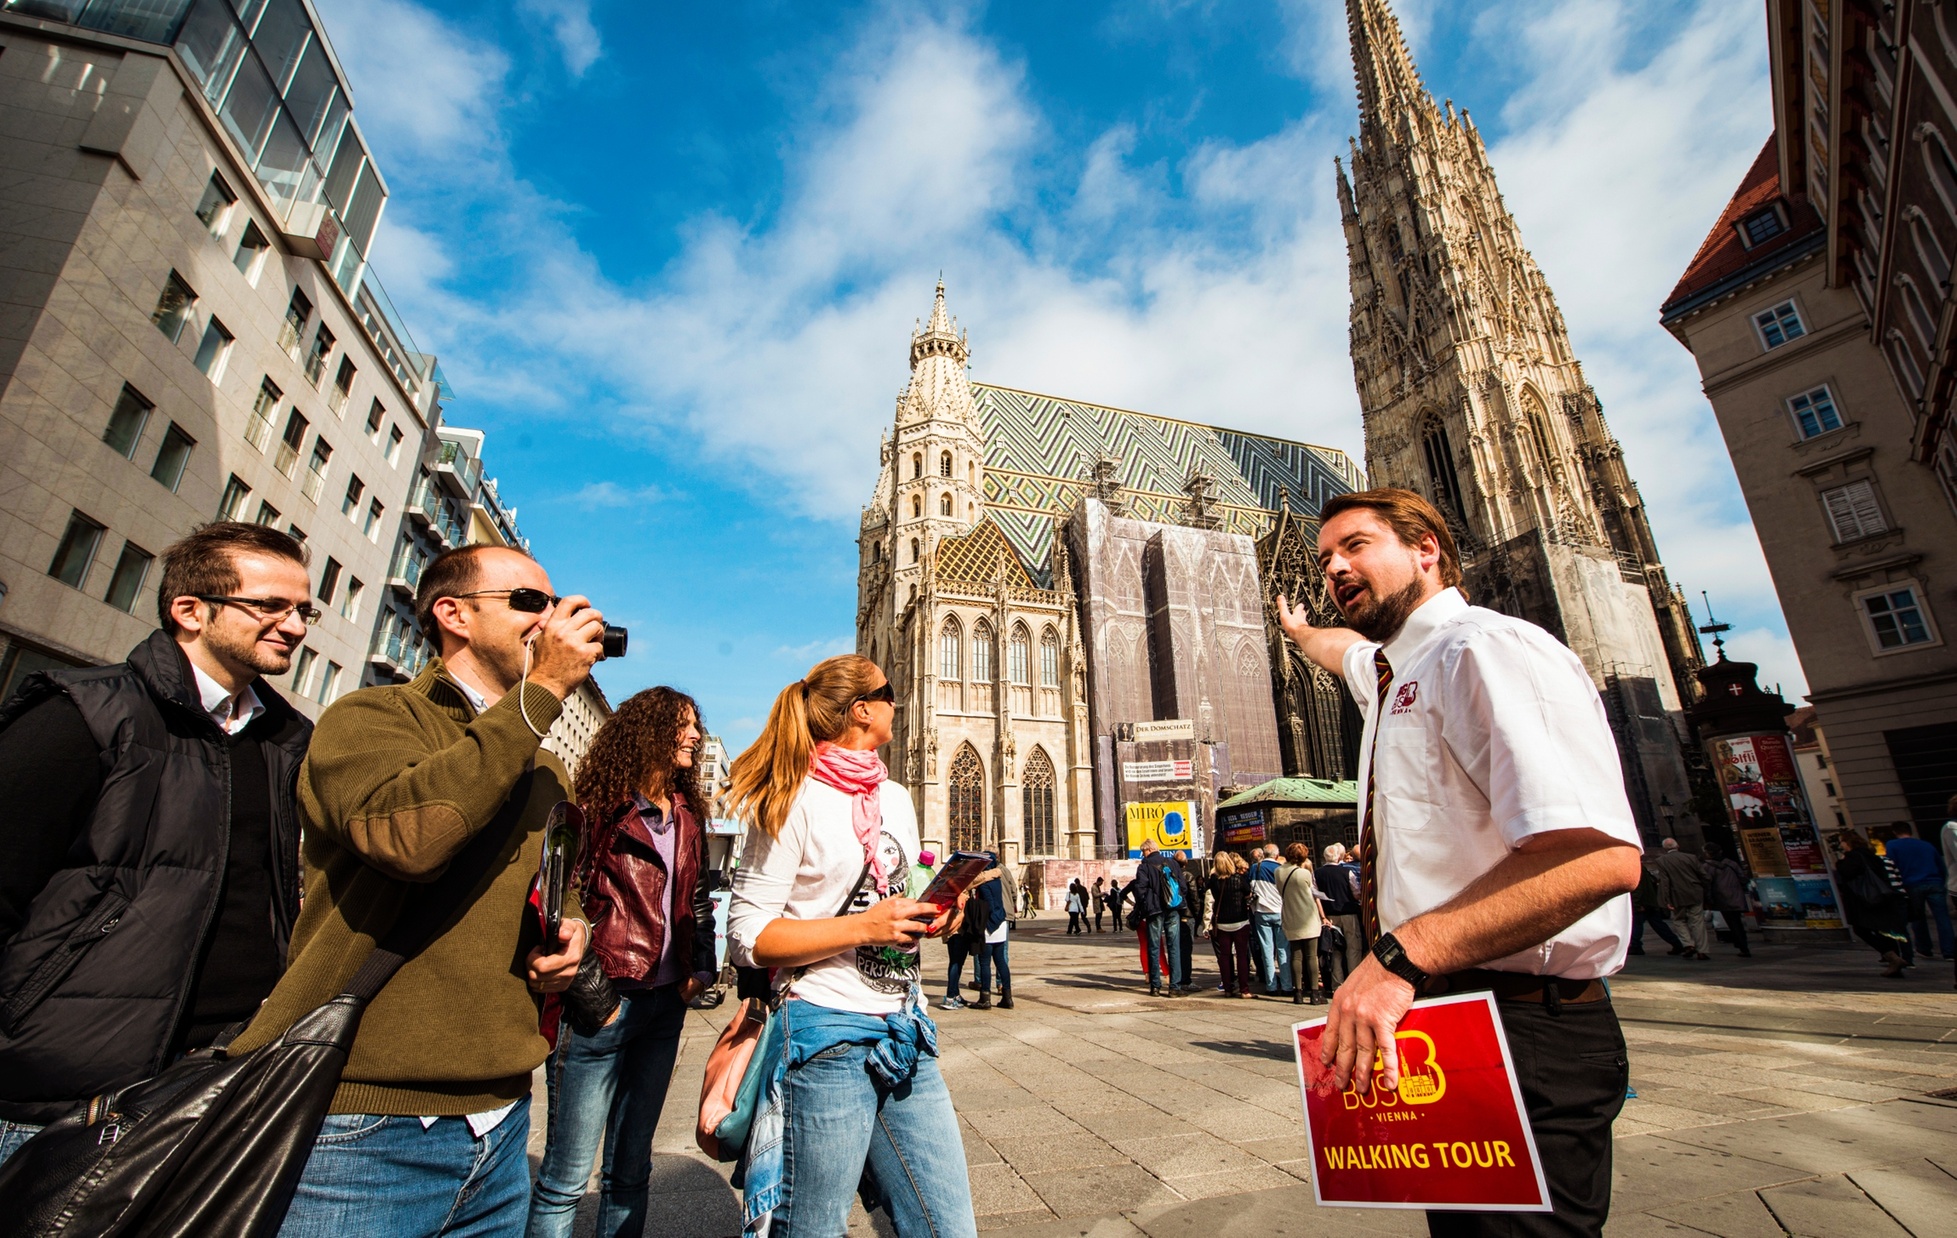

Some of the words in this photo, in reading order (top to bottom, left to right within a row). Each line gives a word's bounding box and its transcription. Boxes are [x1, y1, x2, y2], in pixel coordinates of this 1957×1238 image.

[1150, 724, 1191, 732] DOMSCHATZ
[1130, 804, 1165, 820] MIRÓ
[1375, 1111, 1418, 1123] VIENNA
[1323, 1143, 1431, 1170] WALKING
[1433, 1140, 1516, 1169] TOUR
